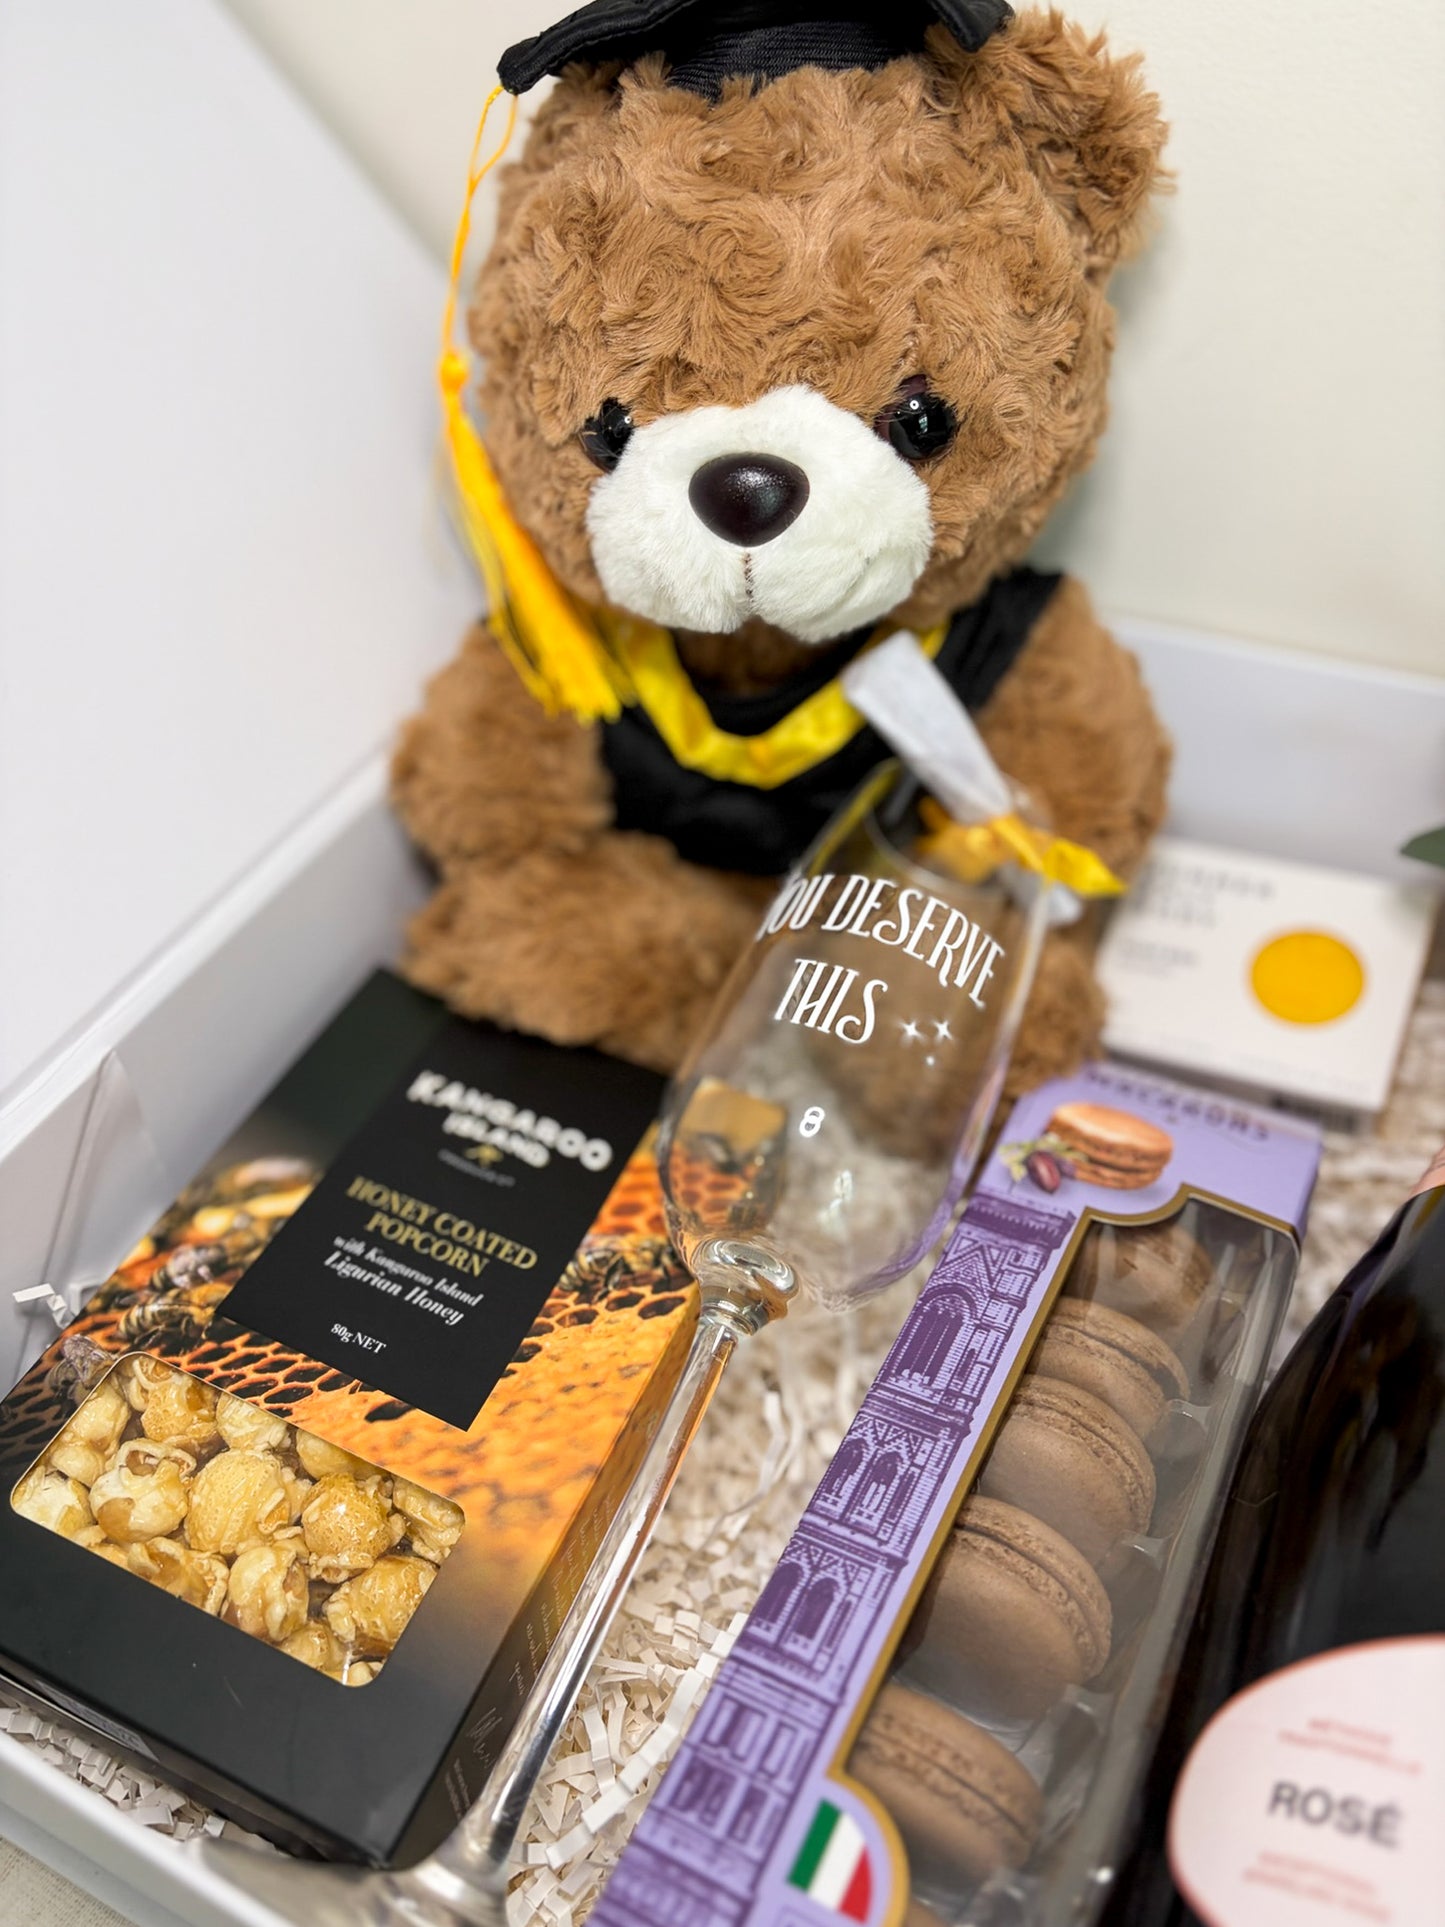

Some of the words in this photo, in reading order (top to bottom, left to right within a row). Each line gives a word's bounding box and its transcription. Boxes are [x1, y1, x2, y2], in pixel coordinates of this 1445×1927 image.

[821, 874, 1005, 1010] DESERVE
[773, 958, 888, 1044] THIS
[406, 1069, 613, 1172] KANGAROO
[346, 1175, 438, 1226] HONEY
[433, 1212, 538, 1271] COATED
[364, 1211, 490, 1278] POPCORN
[324, 1251, 403, 1297] Ligurian
[404, 1286, 465, 1326] Honey
[333, 1236, 366, 1257] with
[365, 1246, 434, 1287] Kangaroo
[434, 1277, 484, 1307] Island
[330, 1322, 352, 1344] 80g
[351, 1331, 387, 1355] NET
